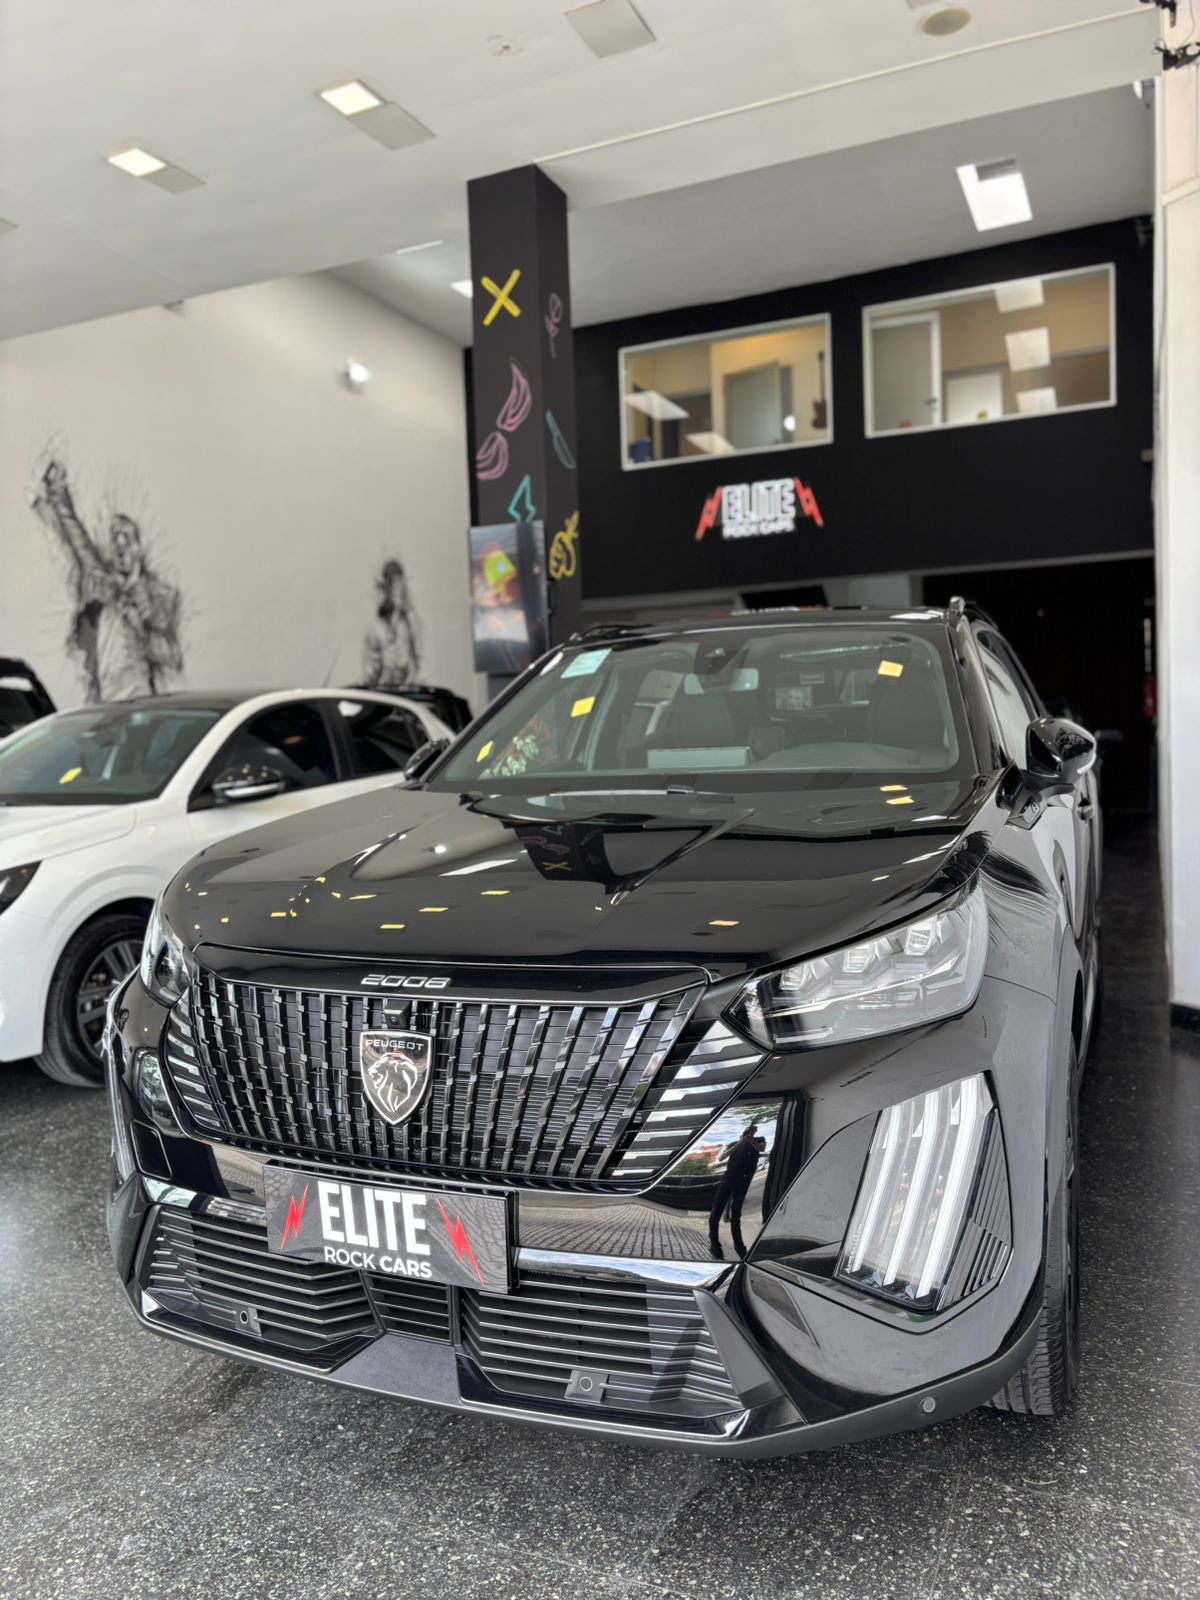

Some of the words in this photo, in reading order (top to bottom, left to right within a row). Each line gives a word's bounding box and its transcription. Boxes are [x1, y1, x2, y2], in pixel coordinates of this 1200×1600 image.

[722, 478, 796, 523] ELITE
[361, 974, 451, 988] 2008
[365, 1039, 424, 1050] PEUGEOT
[317, 1180, 431, 1256] ELITE
[324, 1246, 376, 1270] ROCK
[379, 1256, 432, 1278] CARS
